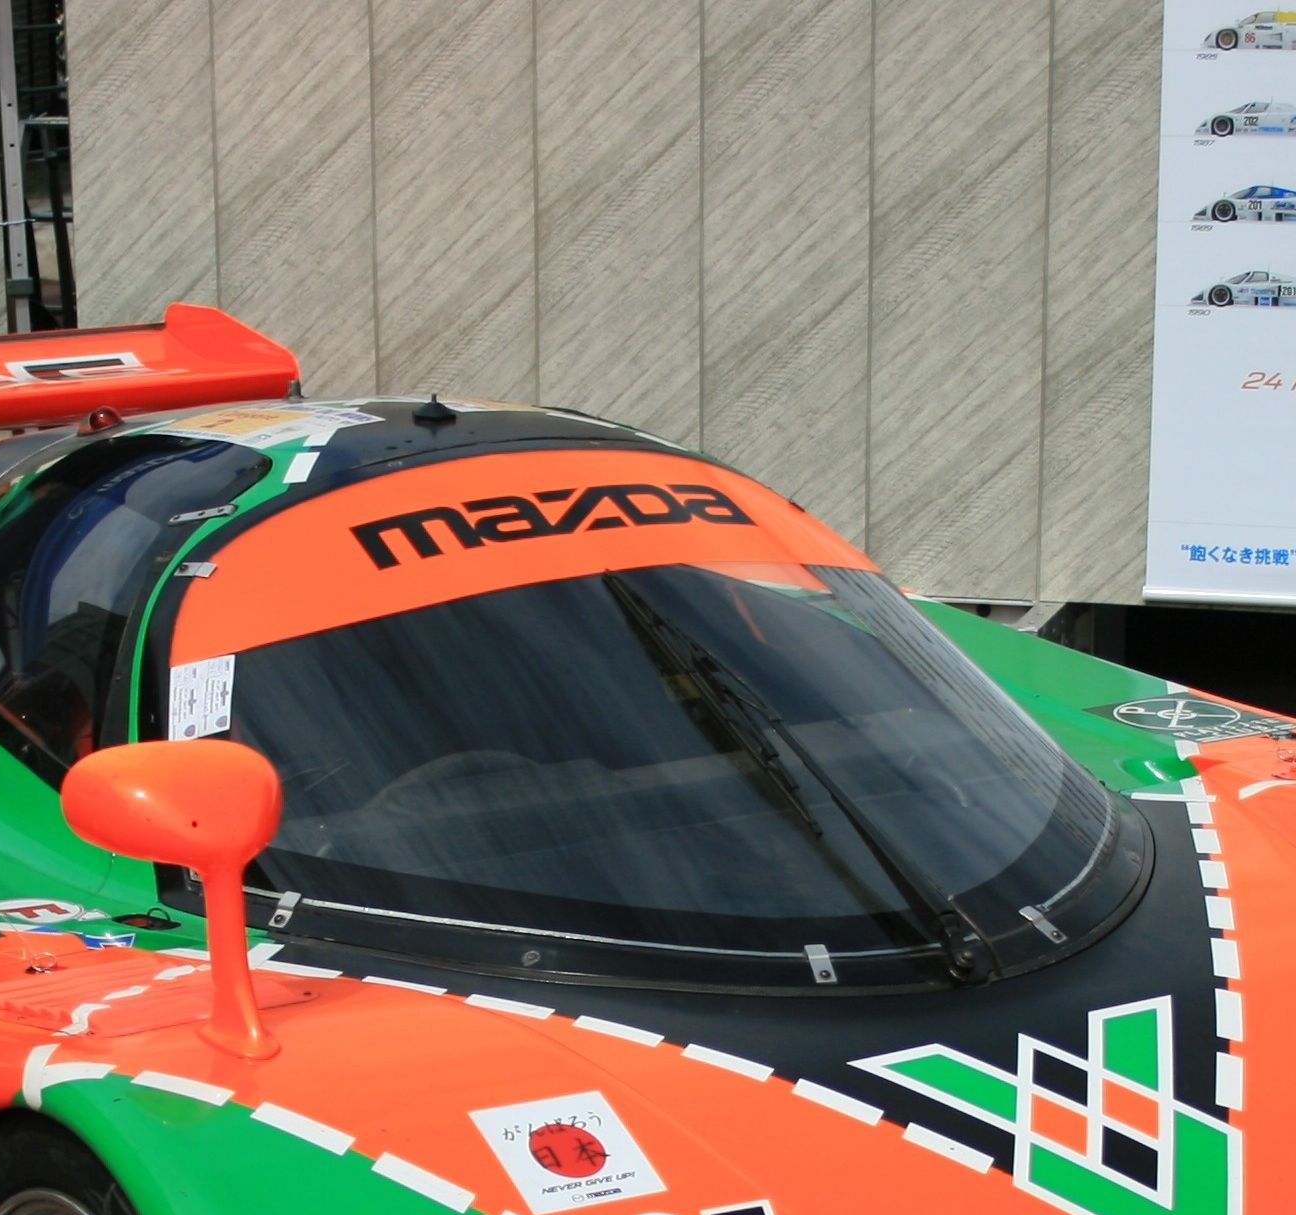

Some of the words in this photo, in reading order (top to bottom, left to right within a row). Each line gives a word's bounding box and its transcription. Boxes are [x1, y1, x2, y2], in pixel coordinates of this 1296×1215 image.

[1243, 115, 1259, 127] 202
[1247, 200, 1262, 211] 201
[1281, 285, 1296, 297] 201
[1241, 371, 1284, 391] 24
[349, 483, 758, 571] mazda
[502, 1111, 603, 1142] がんばろう
[530, 1138, 611, 1170] 日本
[542, 1180, 582, 1195] NEVER
[585, 1175, 613, 1188] GIVE
[616, 1171, 636, 1181] UP!
[585, 1187, 622, 1200] mazda
